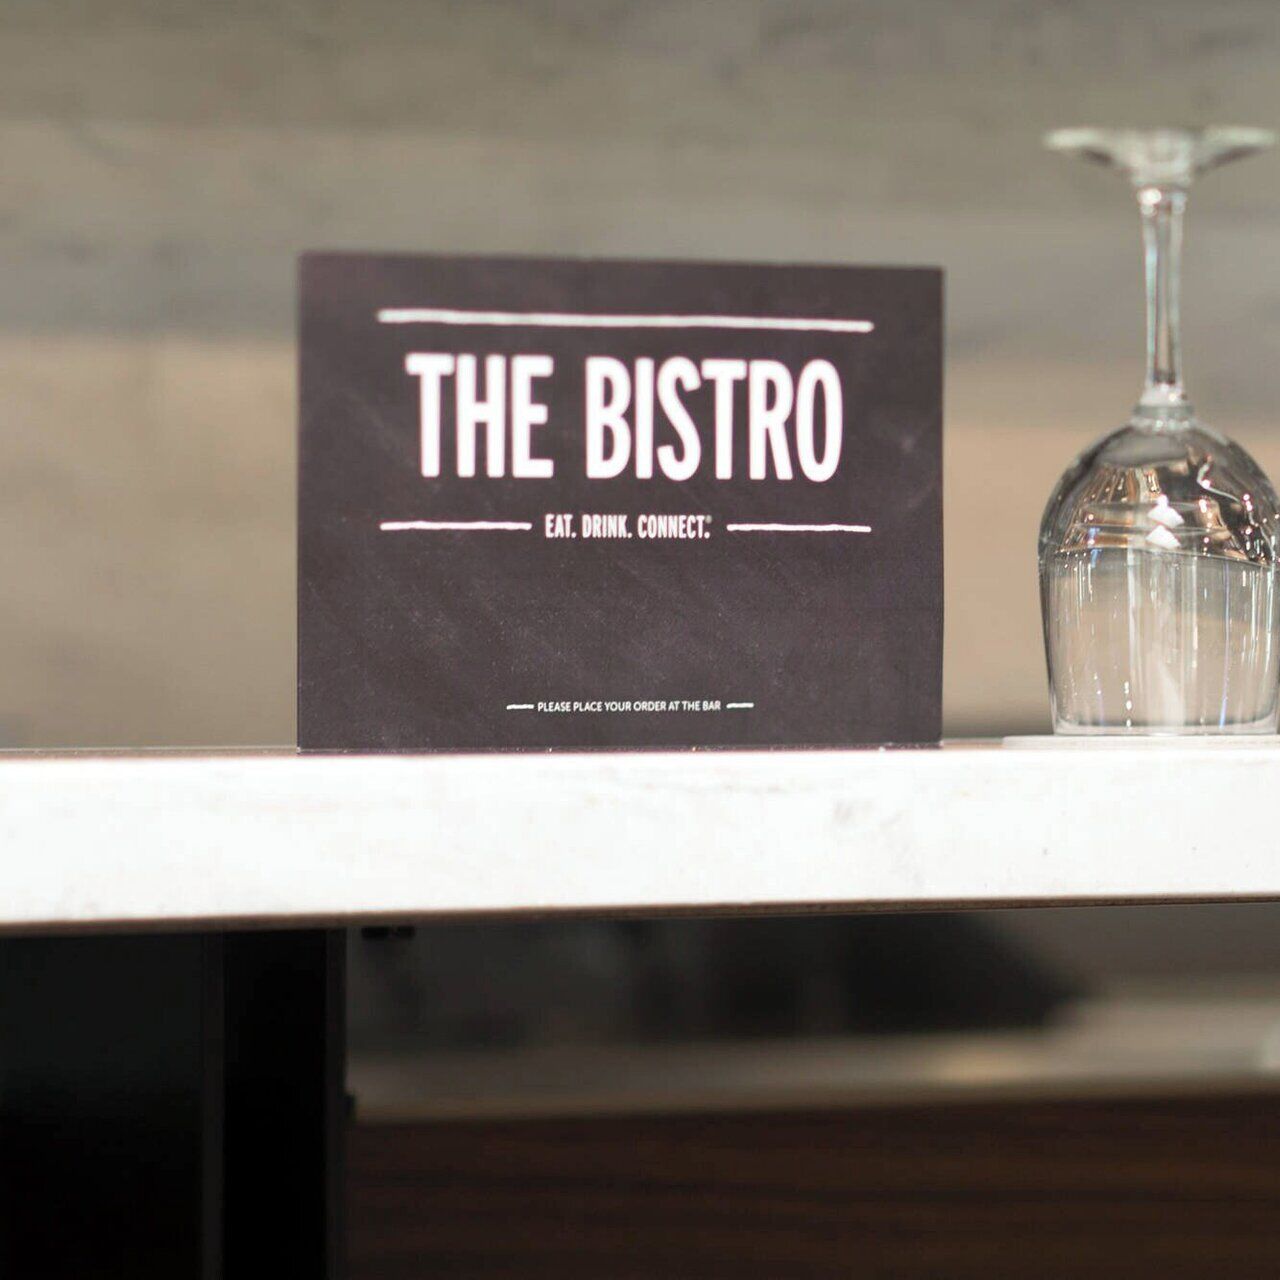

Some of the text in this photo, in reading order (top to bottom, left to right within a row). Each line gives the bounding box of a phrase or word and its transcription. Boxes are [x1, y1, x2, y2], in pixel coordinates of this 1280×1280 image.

[404, 353, 843, 482] THE BISTRO
[545, 514, 577, 538] EAT.
[581, 514, 632, 538] DRINK.
[537, 701, 721, 712] PLEASE PLACE YOUR ORDER AT THE BAR
